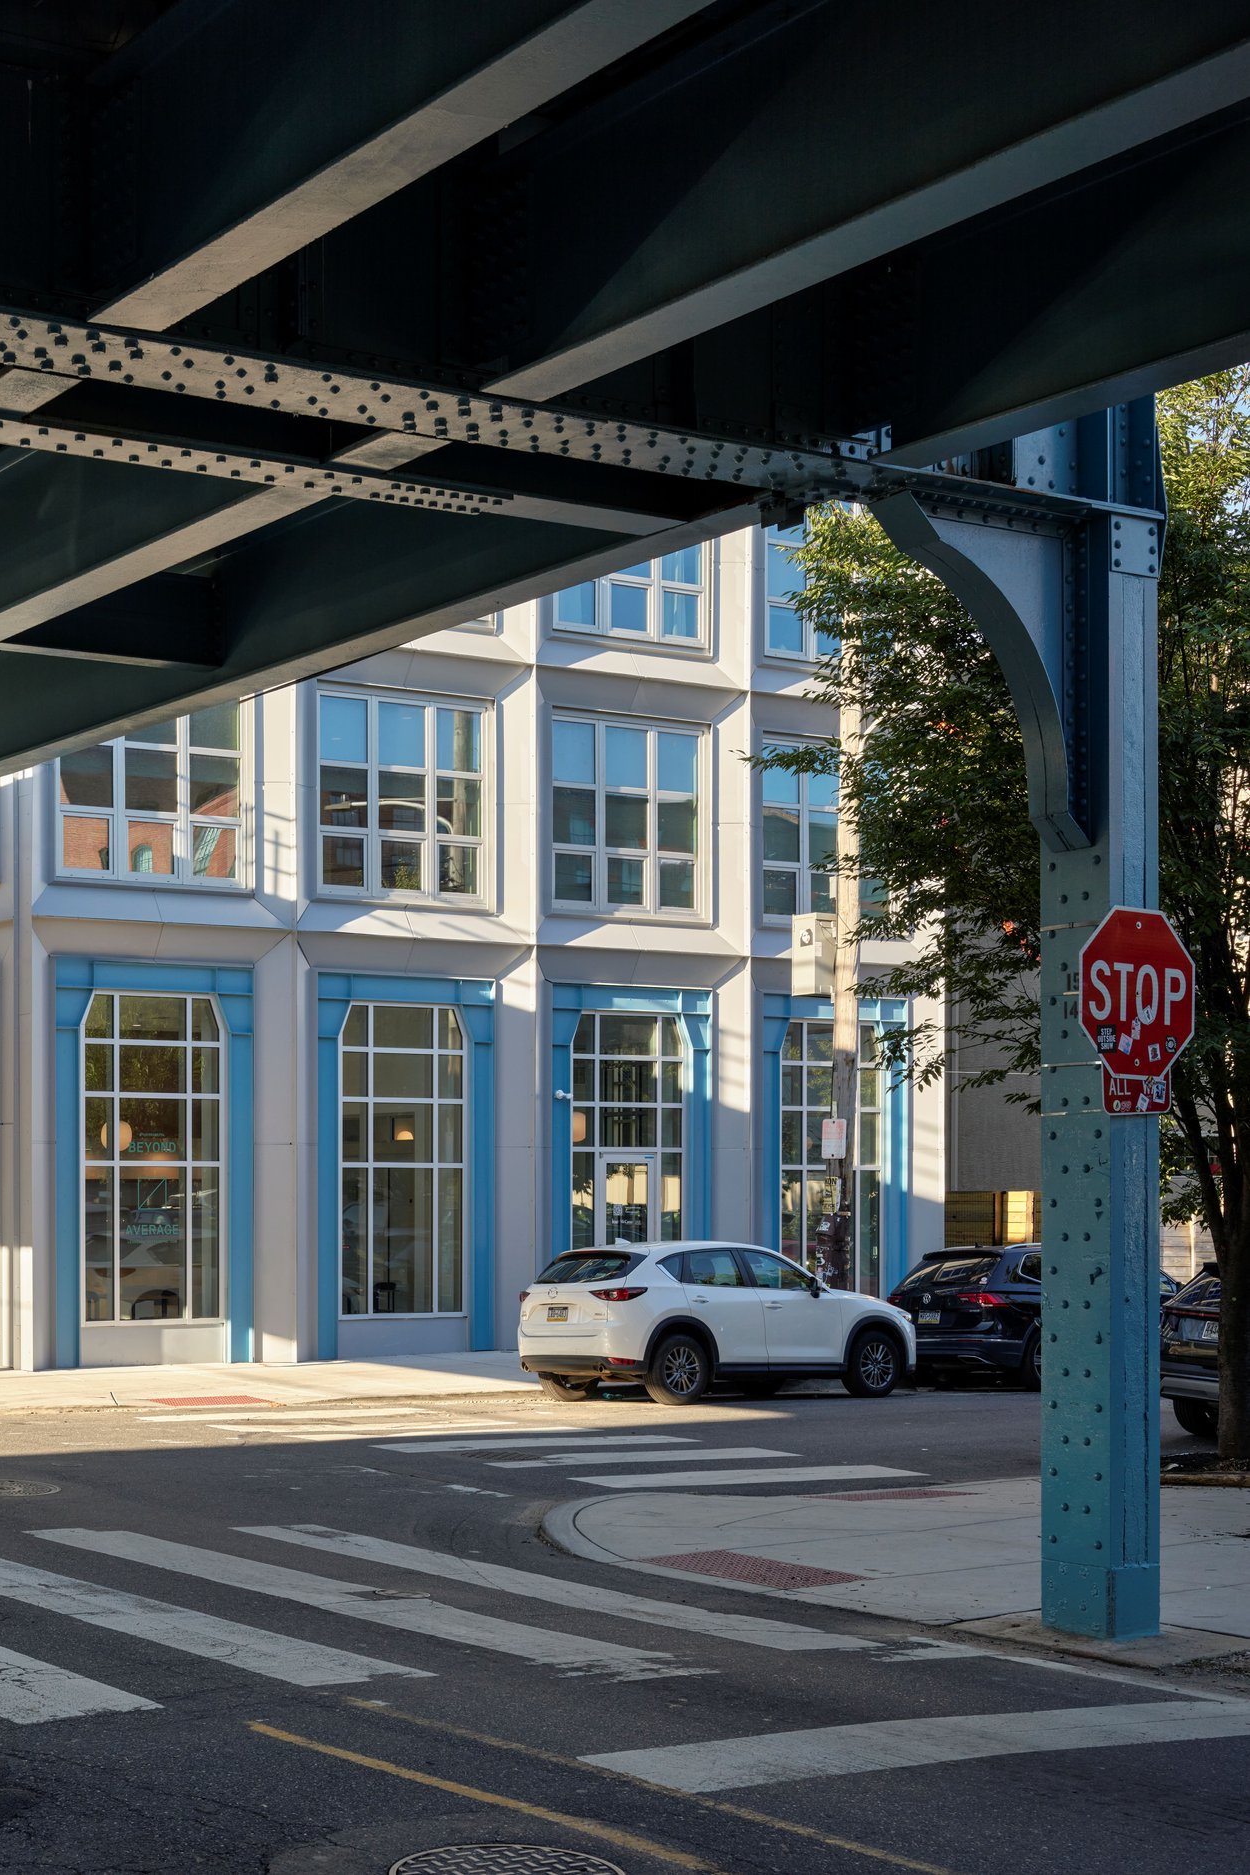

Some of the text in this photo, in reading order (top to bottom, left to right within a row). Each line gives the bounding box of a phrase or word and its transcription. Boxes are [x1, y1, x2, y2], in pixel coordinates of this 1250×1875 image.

[1089, 959, 1187, 1026] STOP
[1100, 1027, 1113, 1036] STEP
[1097, 1034, 1116, 1043] OUTSIDE
[1100, 1042, 1114, 1051] SHOW
[1109, 1078, 1131, 1096] ALL
[128, 1141, 177, 1153] BEYOND
[125, 1224, 179, 1236] AVERAGE
